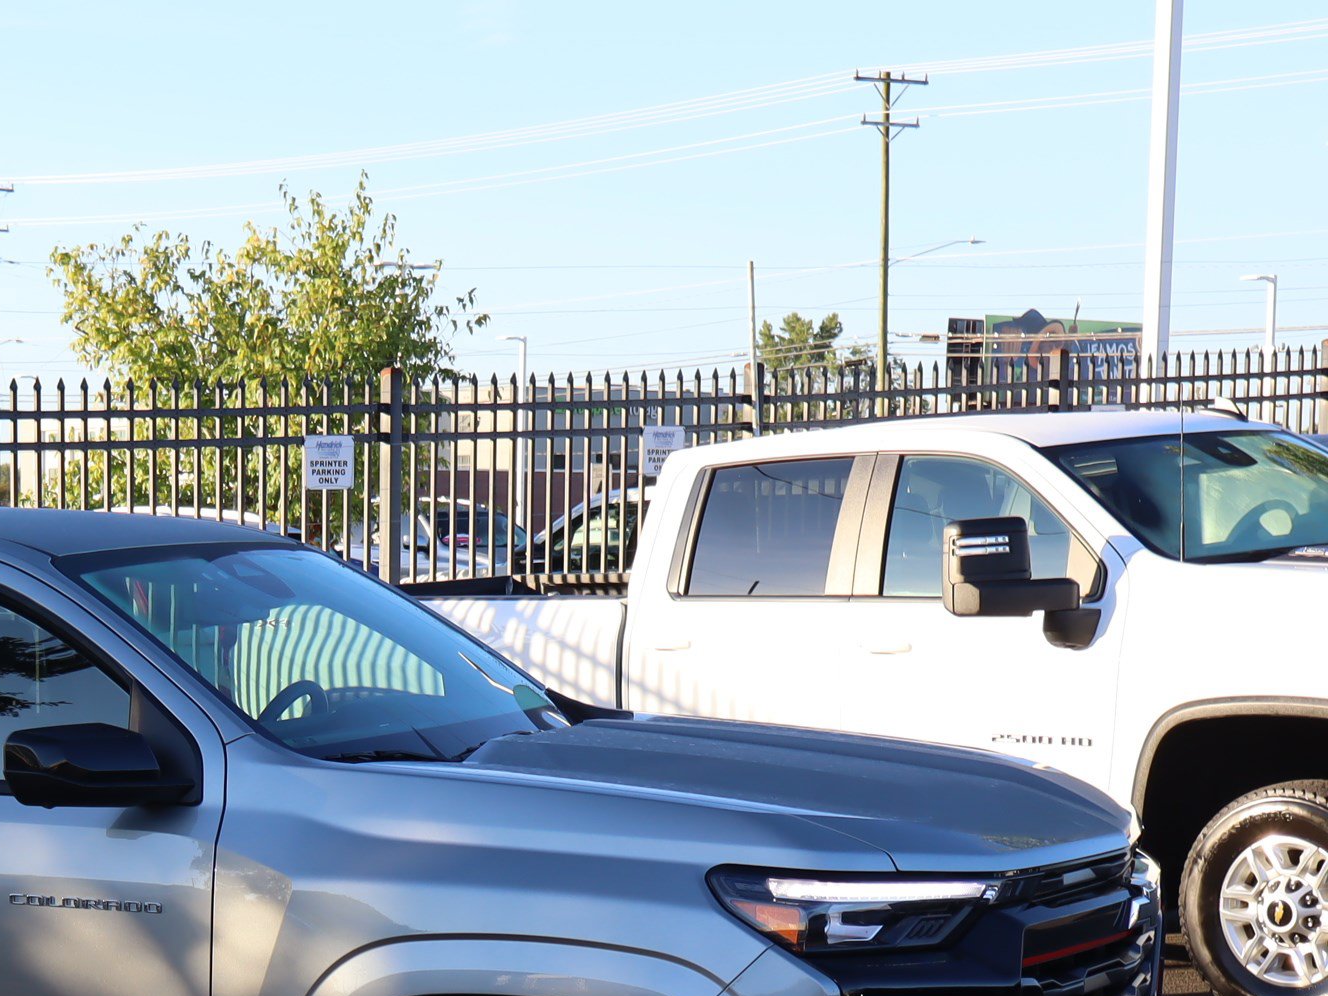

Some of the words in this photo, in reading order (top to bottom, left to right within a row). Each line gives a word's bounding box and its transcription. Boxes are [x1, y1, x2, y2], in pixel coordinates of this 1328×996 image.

[991, 732, 1053, 744] 2500
[1061, 736, 1092, 747] HD
[9, 893, 163, 914] COLORADO
